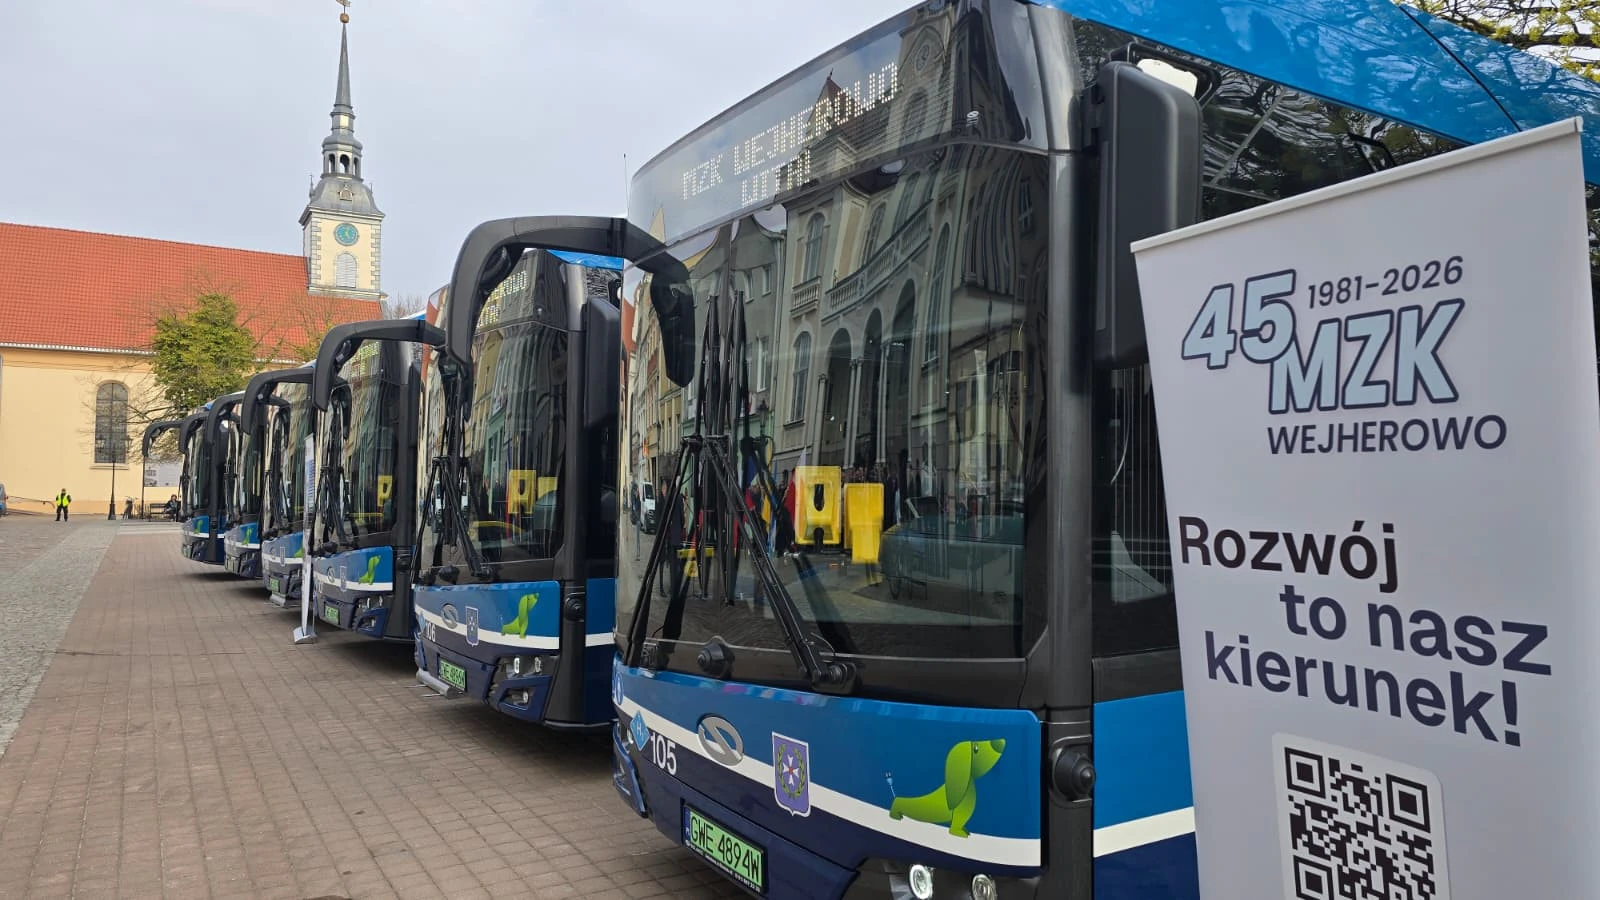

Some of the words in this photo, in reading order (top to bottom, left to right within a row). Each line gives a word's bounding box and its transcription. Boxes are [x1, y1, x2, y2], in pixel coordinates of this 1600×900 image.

[683, 154, 723, 200] MZK
[733, 61, 898, 176] WEJHEROWO
[1181, 268, 1297, 370] 45
[1268, 298, 1465, 414] MZK
[1267, 414, 1507, 455] WEJHEROWO
[1178, 515, 1399, 594] Rozwój
[1279, 584, 1347, 640] to
[1367, 602, 1552, 676] nasz
[1205, 630, 1521, 748] kierunek!
[650, 731, 677, 775] 105
[690, 815, 714, 854] GWE
[718, 834, 760, 883] 4894W
